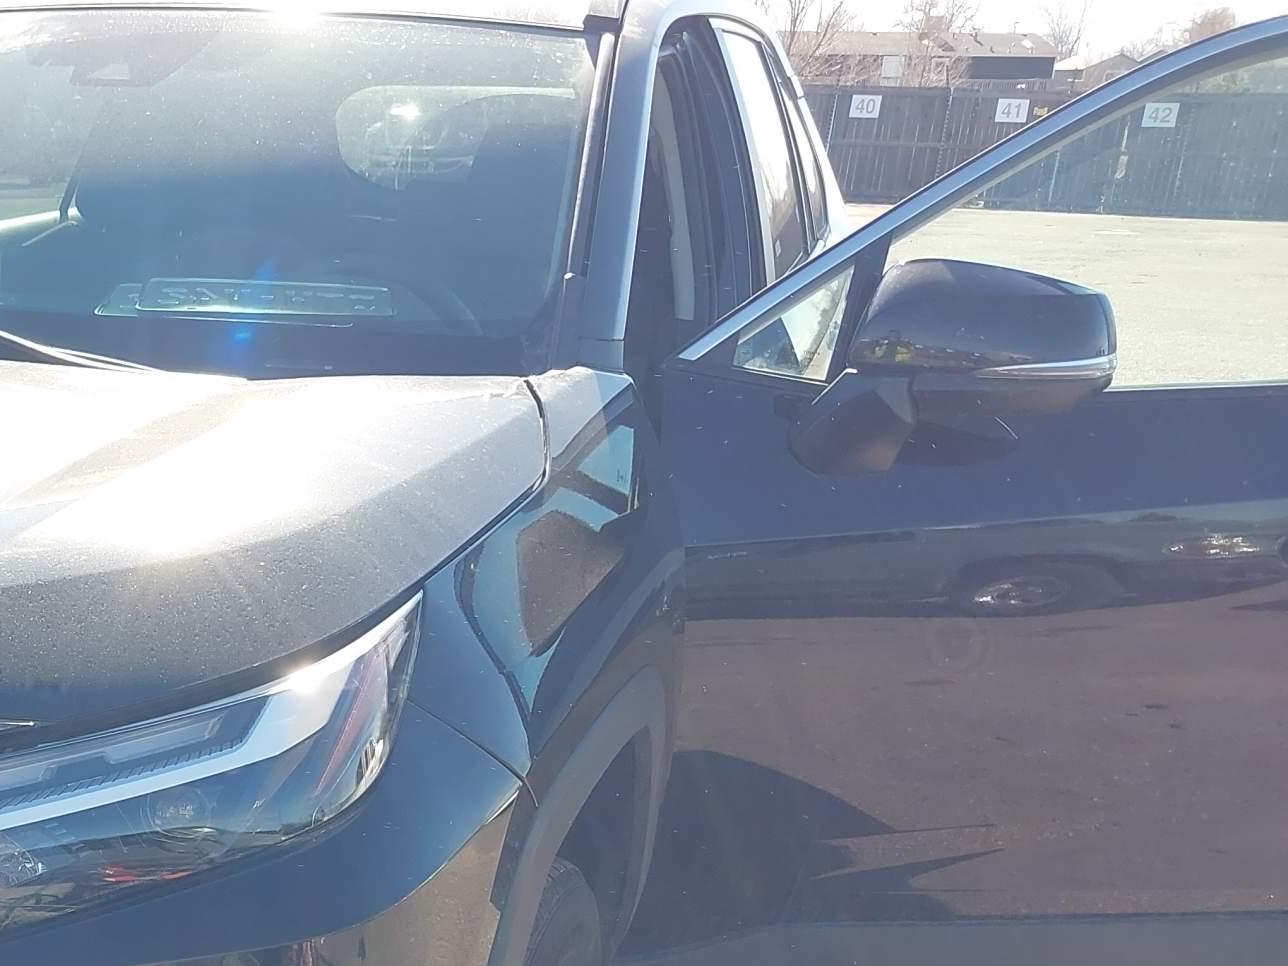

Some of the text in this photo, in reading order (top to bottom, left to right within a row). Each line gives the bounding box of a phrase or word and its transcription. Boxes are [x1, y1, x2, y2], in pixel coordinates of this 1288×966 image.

[856, 98, 876, 113] 40
[1001, 102, 1022, 118] 41
[1148, 106, 1172, 123] 42
